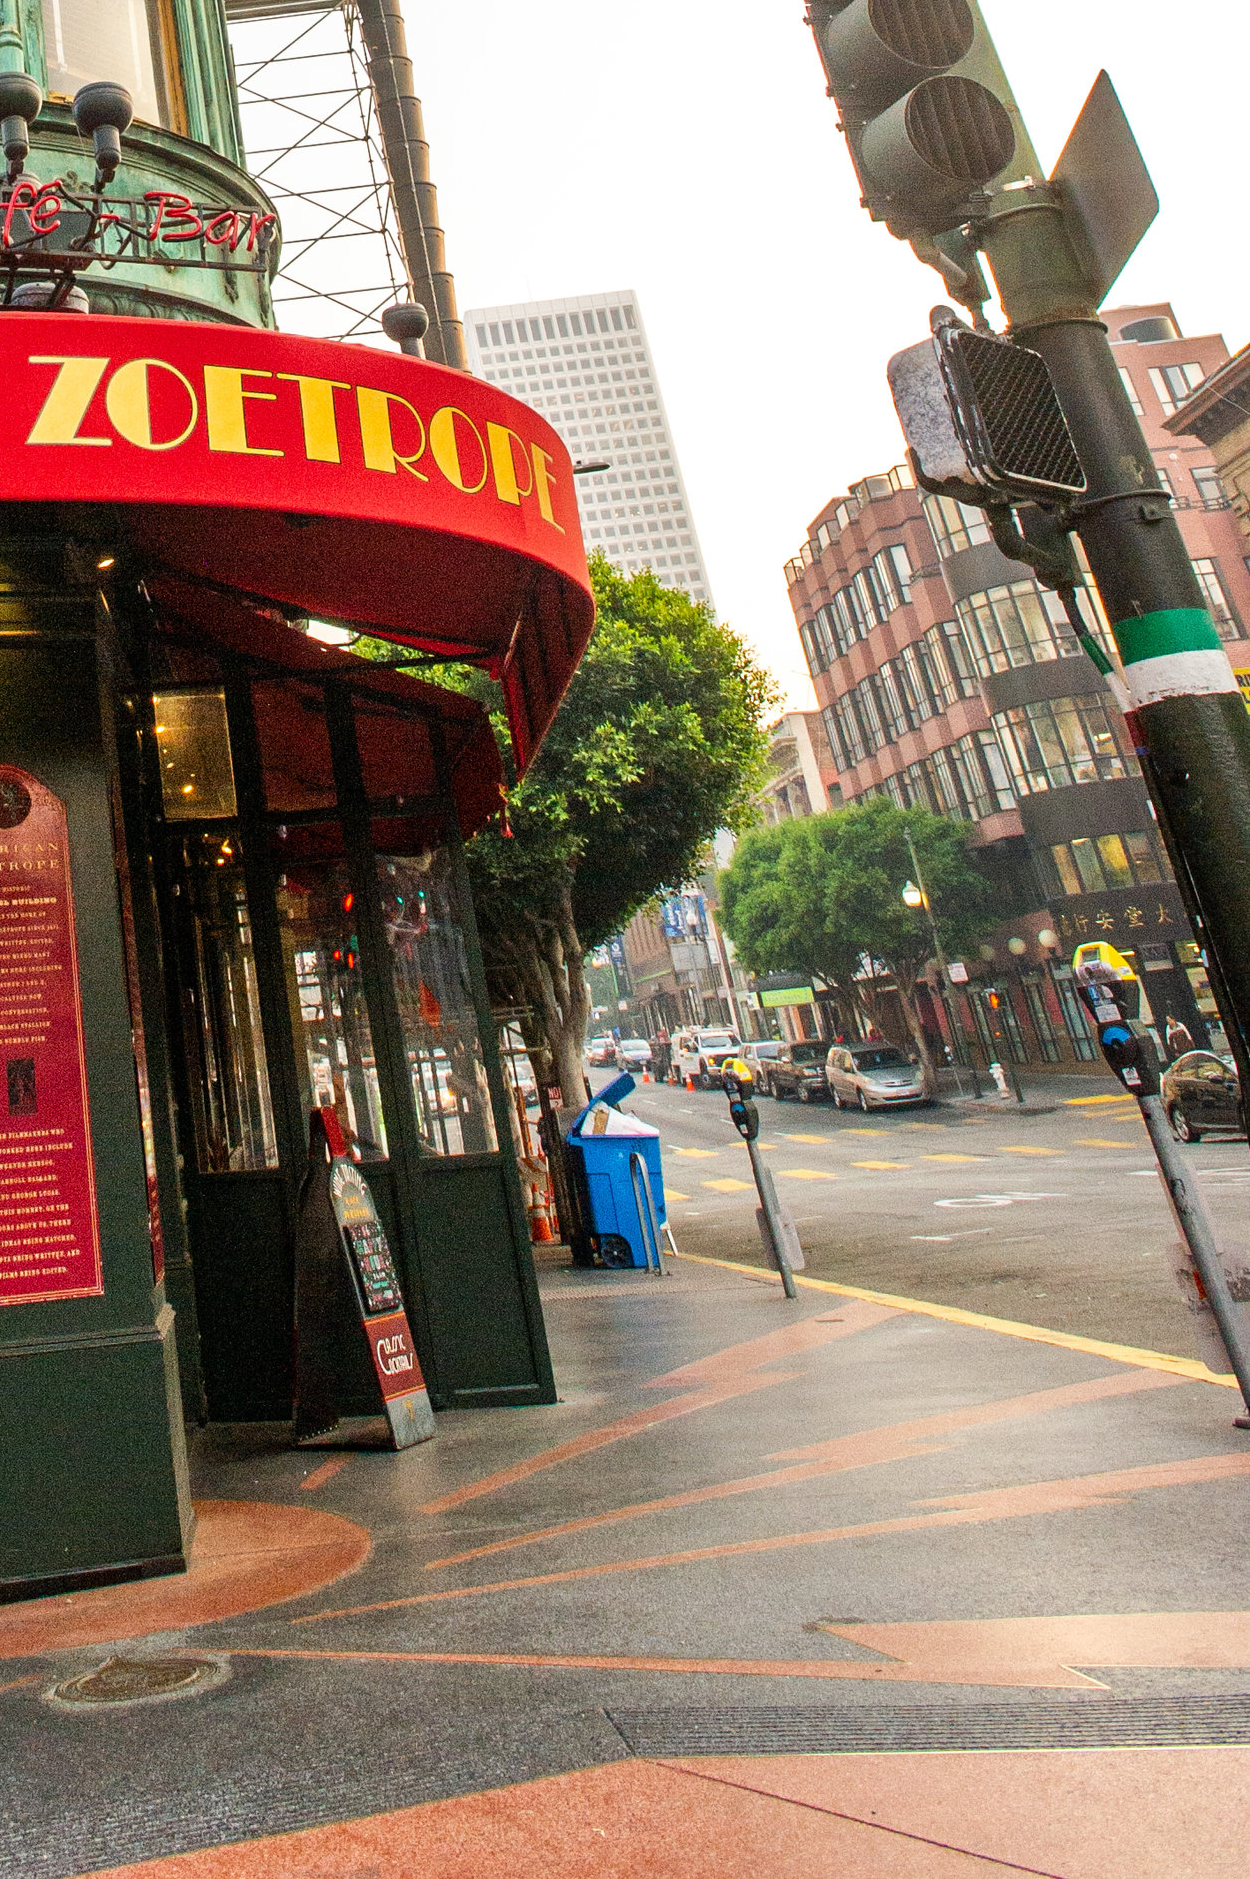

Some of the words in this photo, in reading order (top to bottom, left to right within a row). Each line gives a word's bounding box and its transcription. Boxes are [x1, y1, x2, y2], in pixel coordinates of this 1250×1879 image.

[143, 190, 277, 252] Bar
[26, 355, 567, 535] ZOETROPE
[11, 897, 57, 906] BUILDING
